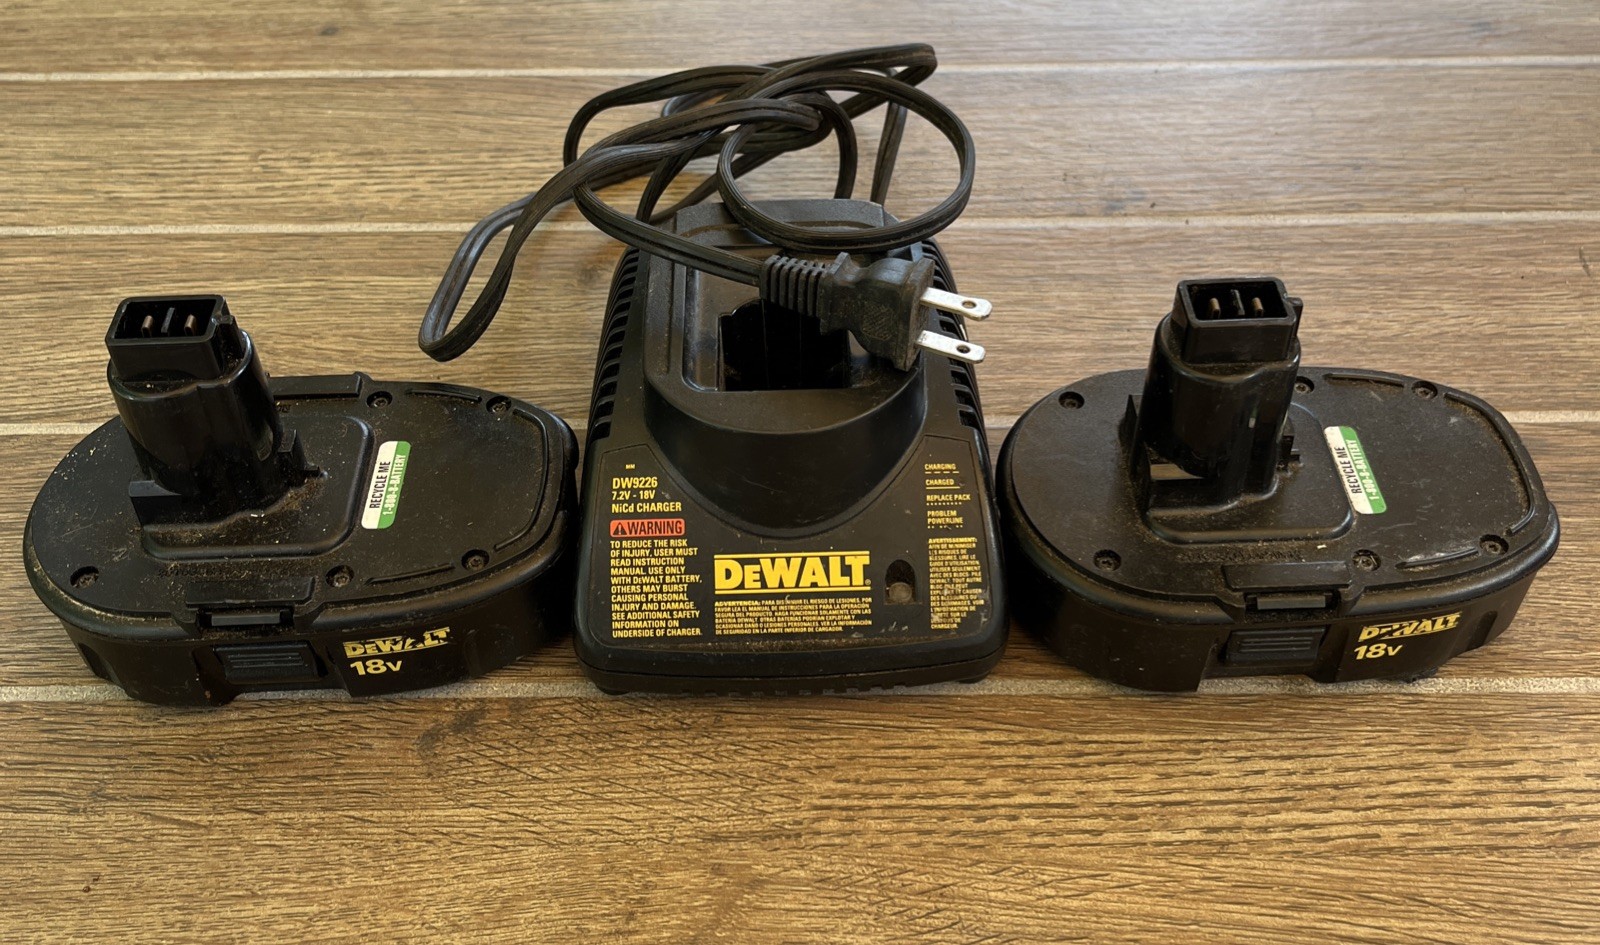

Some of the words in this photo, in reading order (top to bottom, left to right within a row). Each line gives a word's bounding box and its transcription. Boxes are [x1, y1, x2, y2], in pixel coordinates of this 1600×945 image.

[1334, 446, 1348, 458] ME
[378, 461, 390, 473] ME
[926, 478, 954, 486] CHARGED
[1340, 460, 1362, 494] RECYCLE
[612, 476, 658, 490] DW9226
[369, 475, 388, 508] RECYCLE
[612, 490, 631, 500] 7.2V
[640, 490, 656, 500] 18V
[612, 503, 634, 513] NiCd
[636, 502, 682, 512] CHARGER
[928, 516, 964, 524] POWERLINE
[628, 520, 682, 536] WARNING
[610, 540, 620, 548] TO
[622, 540, 652, 548] REDUCE
[654, 540, 668, 548] THE
[670, 539, 688, 548] RISK
[610, 550, 620, 558] OF
[622, 549, 652, 558] INJURY,
[654, 548, 674, 556] USER
[676, 548, 698, 556] MUST
[610, 558, 631, 566] READ
[632, 558, 684, 566] INSTRUCTION
[610, 568, 646, 576] MANUAL.
[665, 566, 686, 574] ONLY
[714, 555, 870, 590] DEWALT
[610, 576, 631, 584] WITH
[665, 574, 702, 584] BATTERY,
[611, 586, 641, 594] OTHERS
[662, 584, 688, 592] BURST
[612, 594, 646, 602] CAUSING
[648, 593, 688, 602] PERSONAL
[612, 603, 640, 612] INJURY
[642, 602, 659, 610] AND
[660, 602, 696, 610] DAMAGE.
[612, 612, 626, 620] SEE
[627, 612, 671, 620] ADDITIONAL
[672, 610, 700, 618] SAFETY
[612, 620, 666, 629] INFORMATION
[668, 620, 680, 628] ON
[612, 630, 654, 638] UNDERSIDE
[656, 629, 666, 637] OF
[666, 628, 702, 636] CHARGER.
